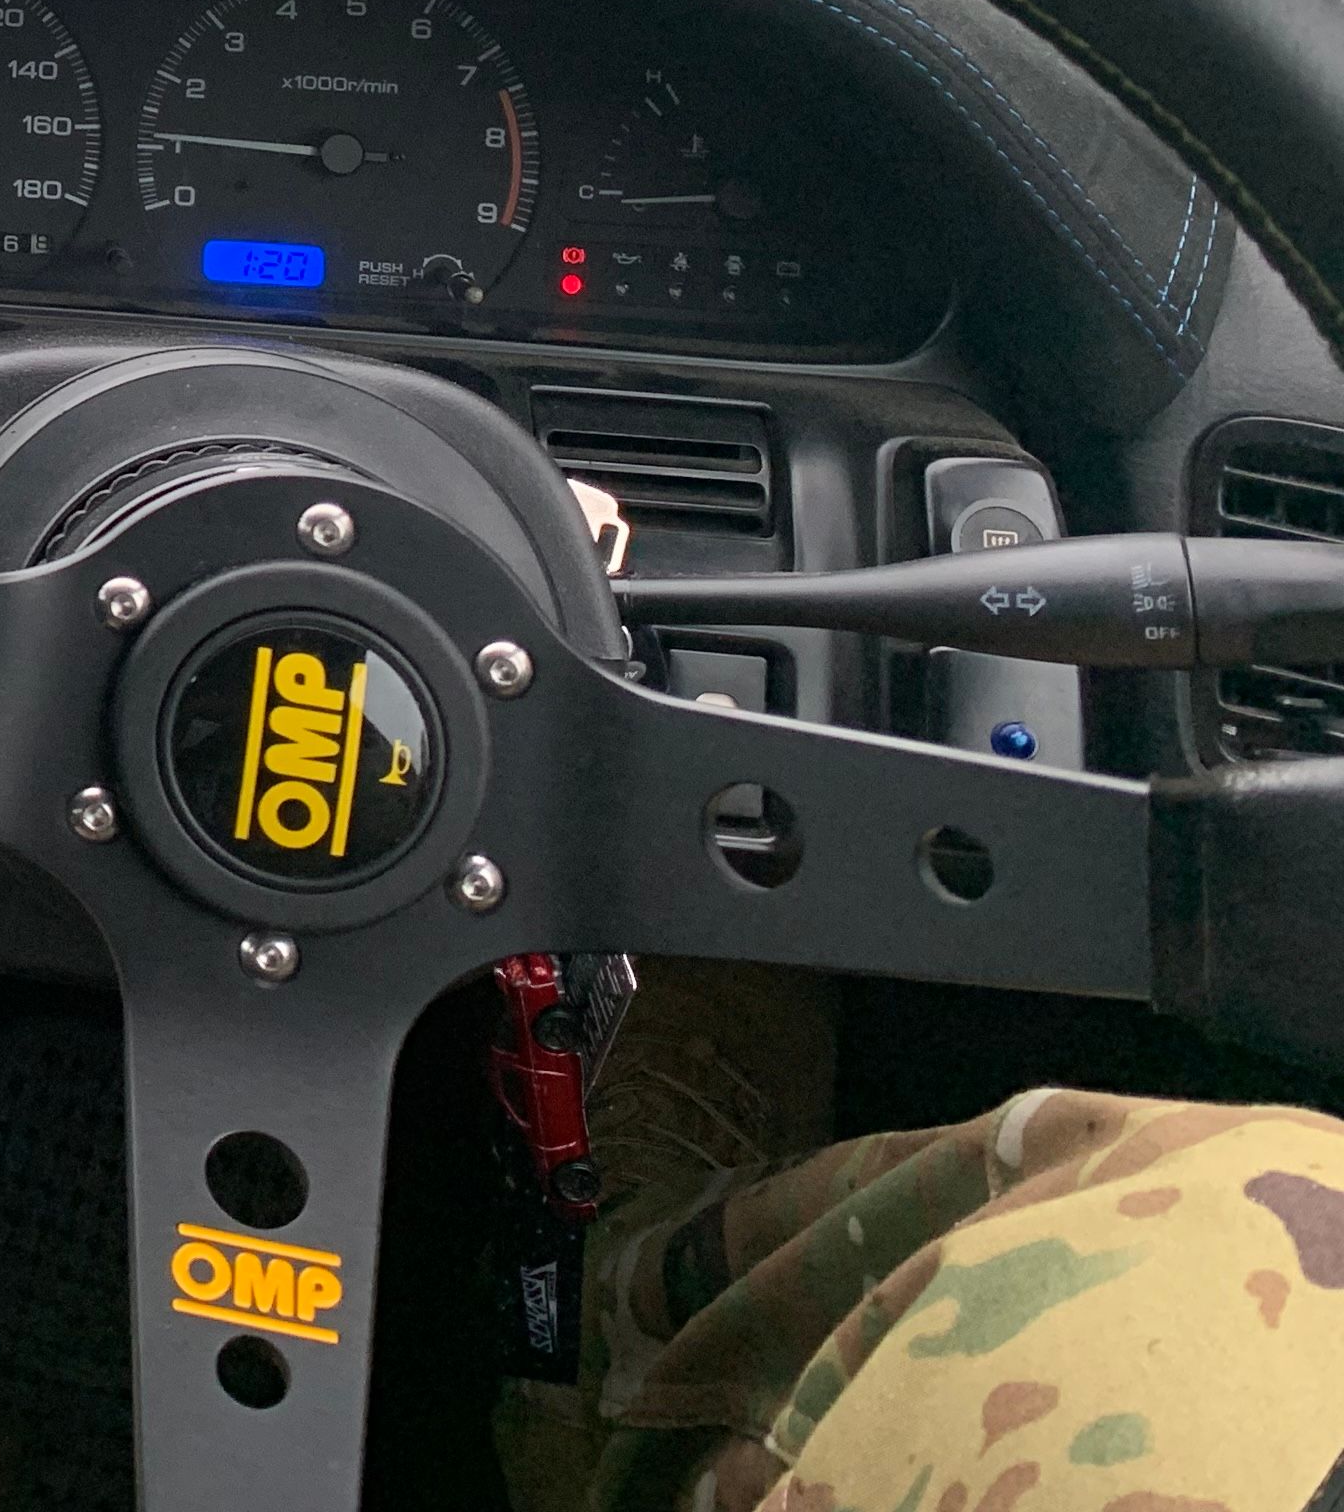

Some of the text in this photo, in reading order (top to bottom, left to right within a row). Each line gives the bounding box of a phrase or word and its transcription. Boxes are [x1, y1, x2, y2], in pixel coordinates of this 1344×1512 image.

[276, 0, 297, 20] 4
[411, 19, 431, 39] 6
[225, 32, 244, 52] 3
[8, 60, 58, 80] 140
[457, 65, 477, 85] 7
[646, 68, 661, 83] H
[186, 78, 205, 98] 2
[22, 116, 72, 136] 160
[485, 127, 505, 148] 8
[12, 179, 62, 199] 180
[174, 186, 195, 206] 0
[578, 184, 594, 199] C
[477, 203, 497, 223] 9
[243, 249, 308, 281] 1:20
[359, 261, 403, 273] PUSH
[359, 274, 410, 286] RESET
[1144, 626, 1180, 641] OFF
[258, 652, 345, 849] OMP
[171, 1241, 343, 1322] OMP
